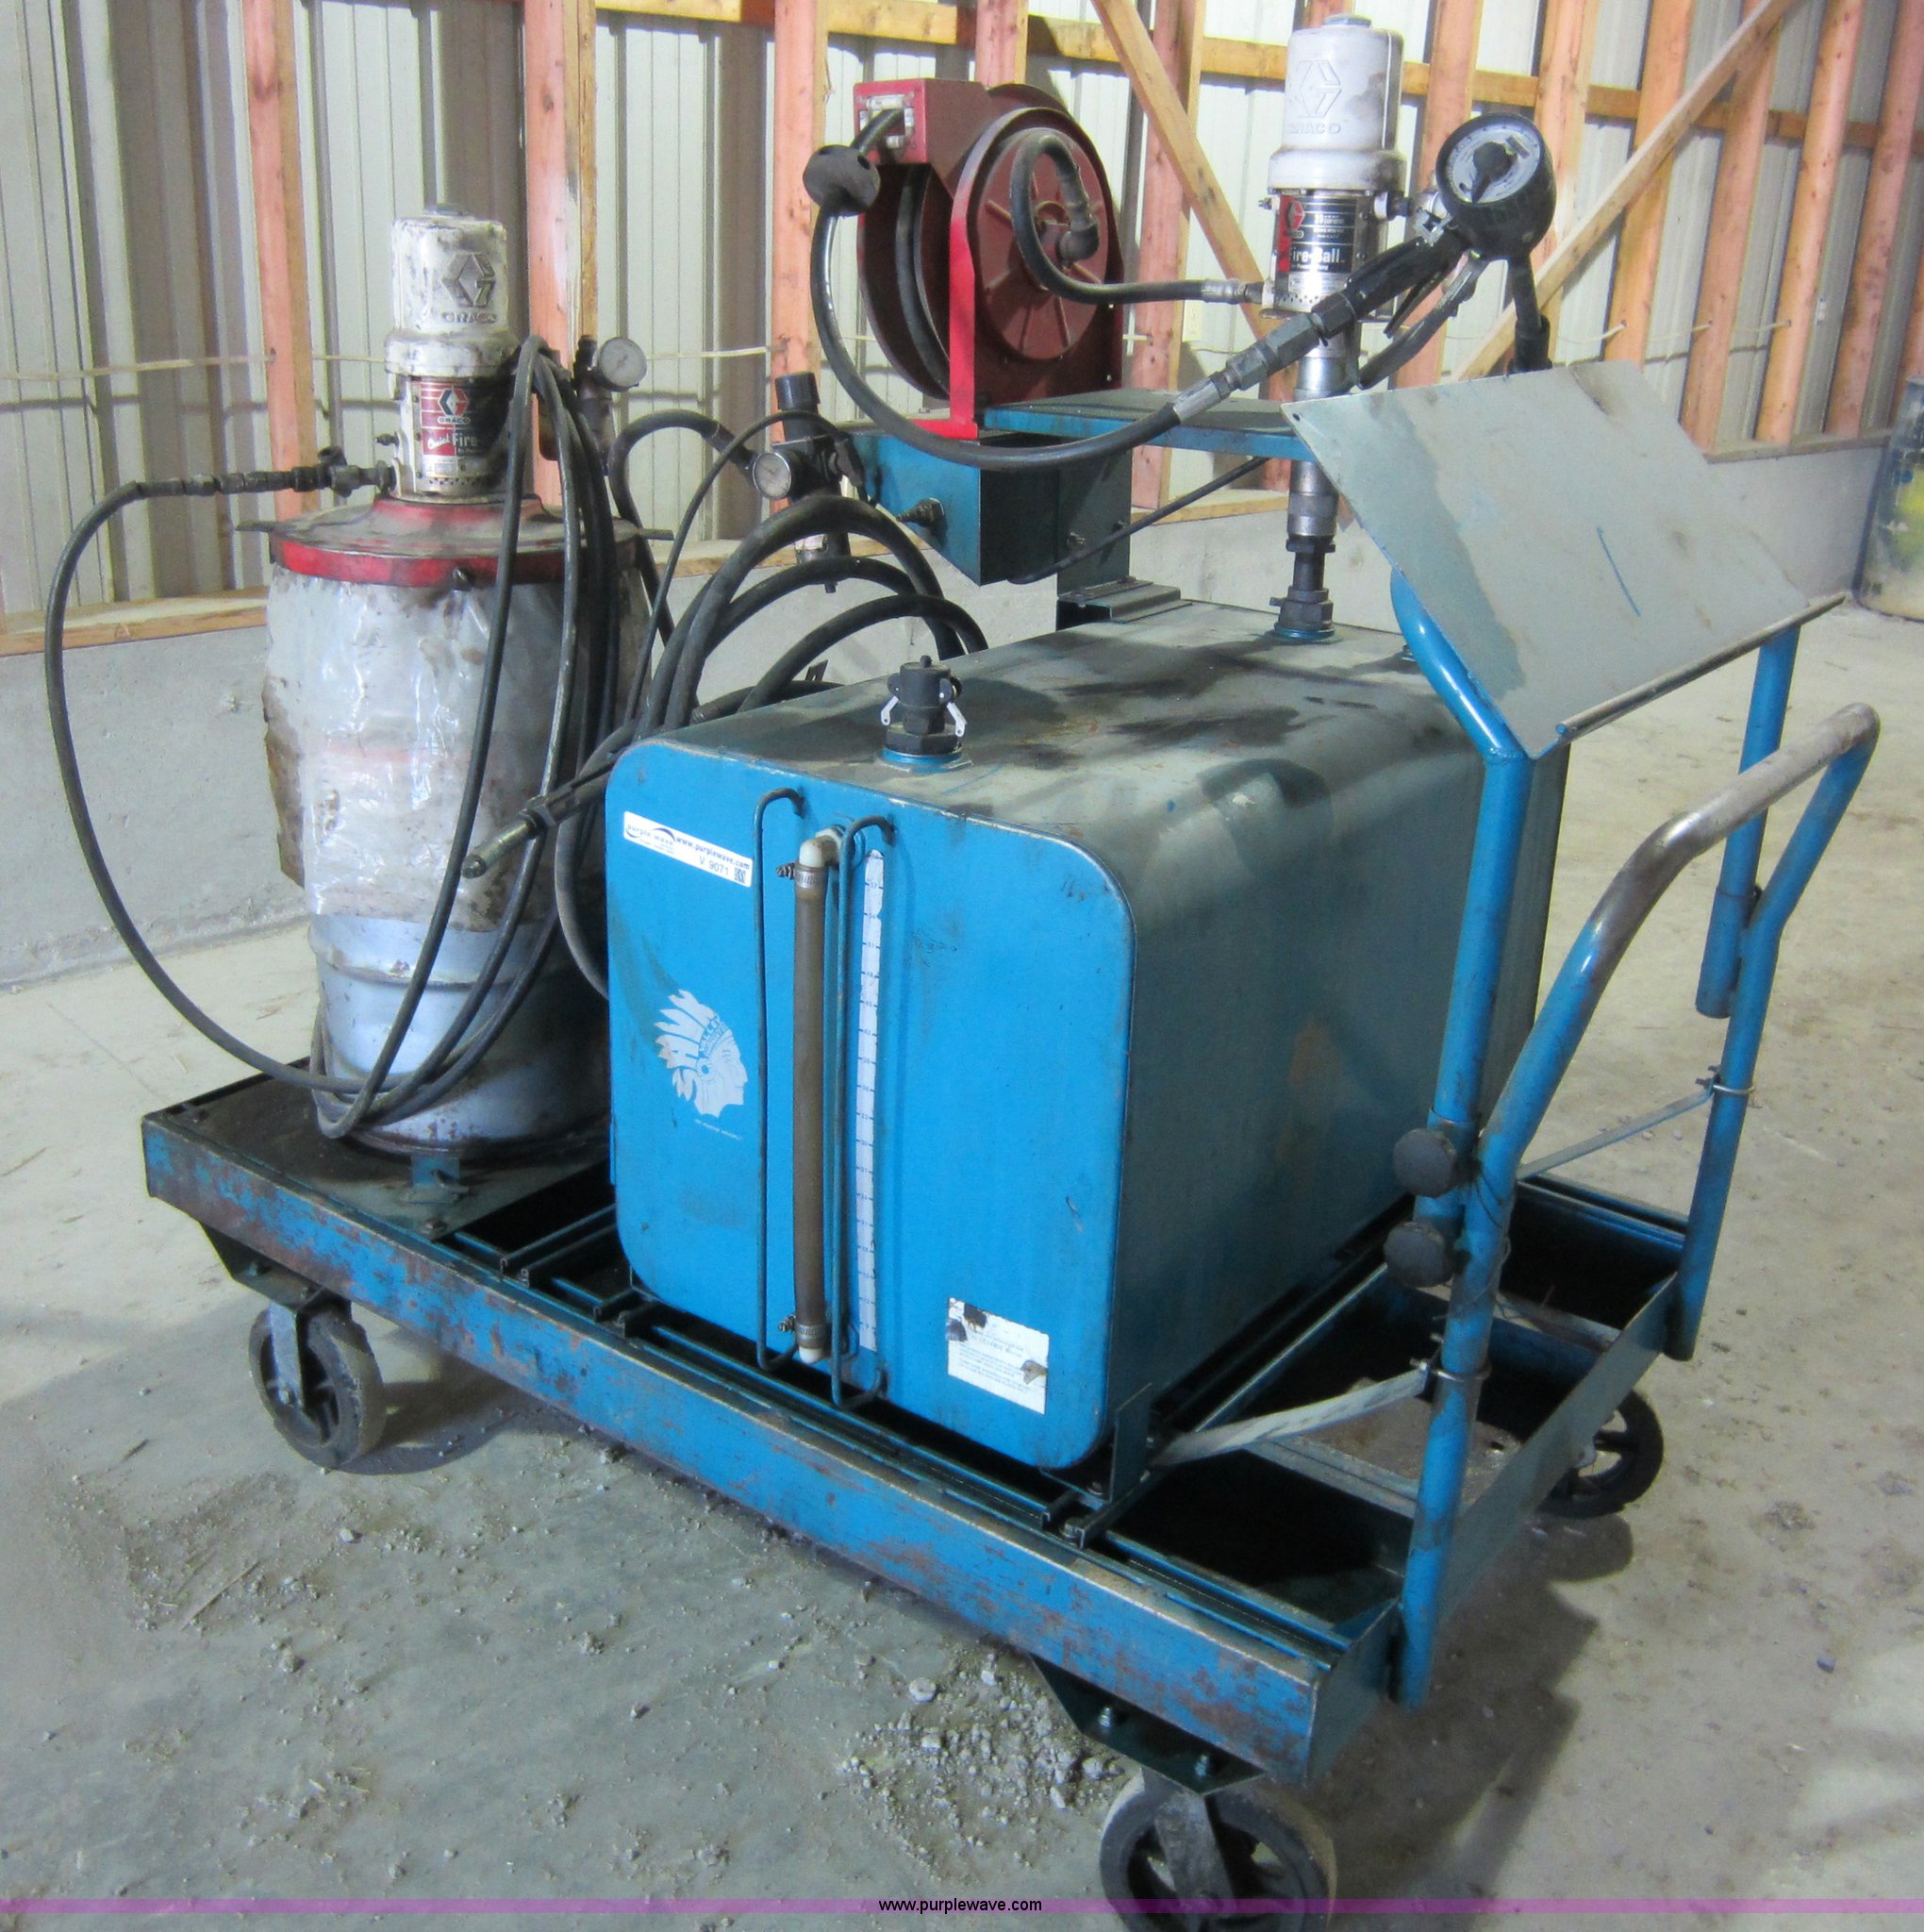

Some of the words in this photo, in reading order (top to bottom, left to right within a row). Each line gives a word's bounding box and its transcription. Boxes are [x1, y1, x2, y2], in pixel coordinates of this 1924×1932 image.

[676, 836, 750, 870] www.purplewave.com
[699, 856, 705, 865] V
[709, 860, 729, 876] 9071
